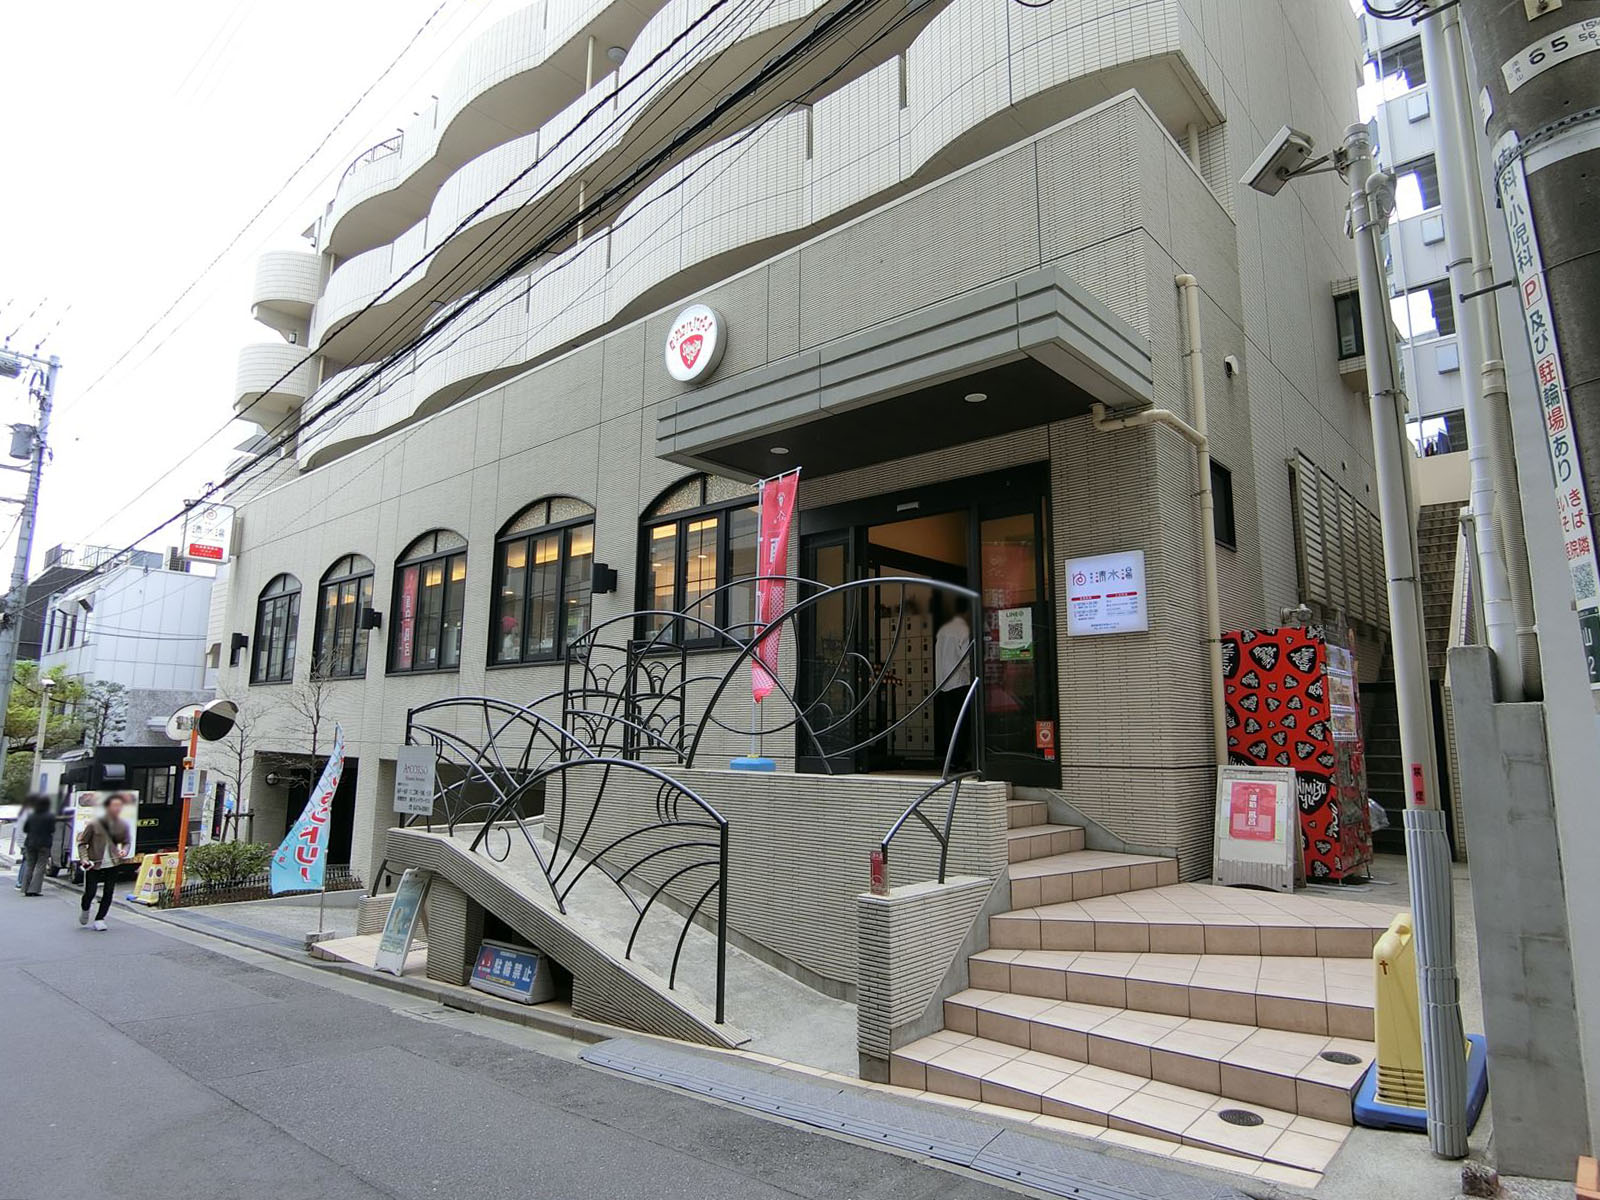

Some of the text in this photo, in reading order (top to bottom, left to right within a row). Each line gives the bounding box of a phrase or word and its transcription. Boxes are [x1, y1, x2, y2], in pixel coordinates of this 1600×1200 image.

[1528, 35, 1570, 65] 65
[492, 957, 532, 983] 駐輪禁止
